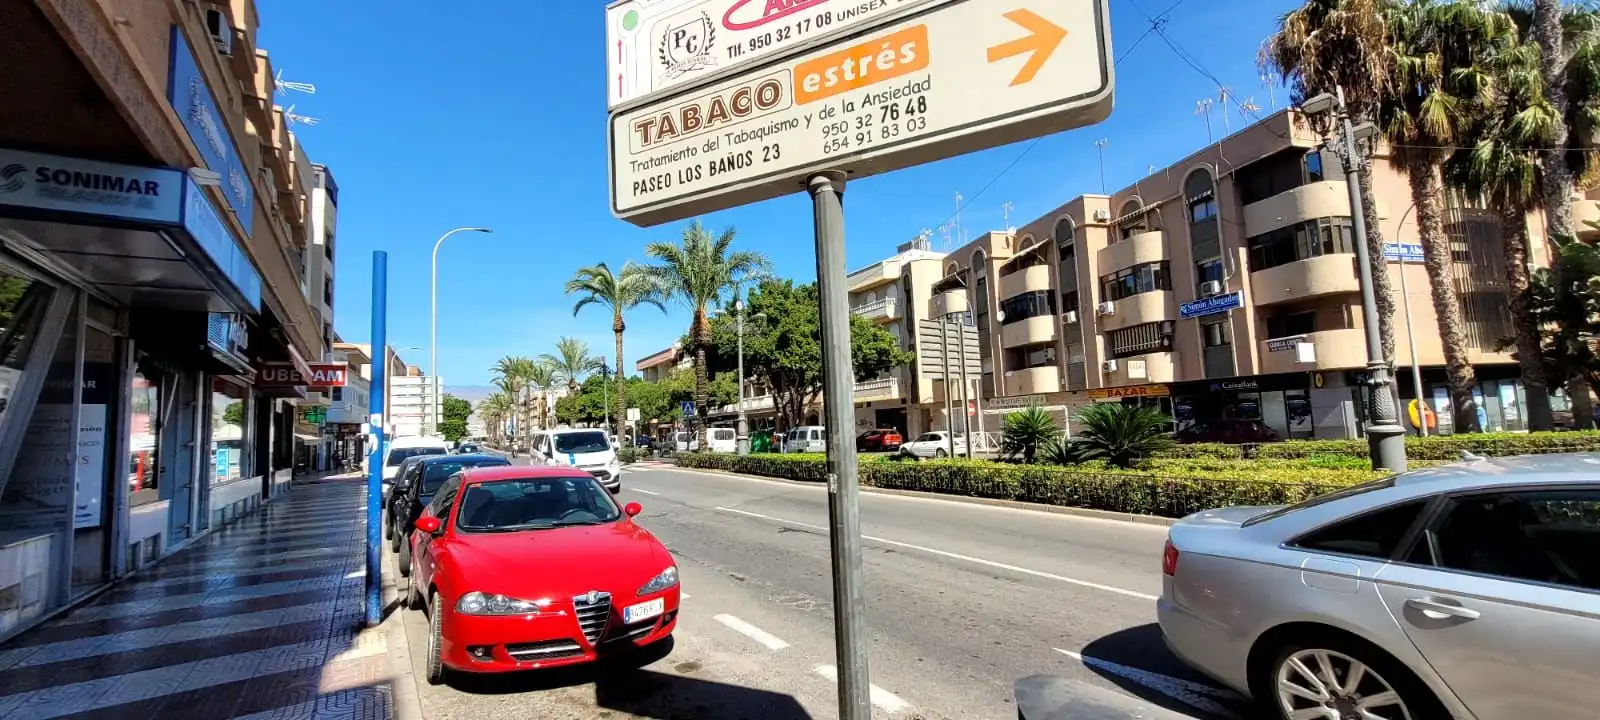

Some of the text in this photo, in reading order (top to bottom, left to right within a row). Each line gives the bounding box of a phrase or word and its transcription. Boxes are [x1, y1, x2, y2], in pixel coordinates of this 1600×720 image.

[727, 0, 887, 59] Tlf. 950 32 17 08 UNISEX
[634, 41, 916, 147] TABACO estrés
[822, 95, 927, 139] 950 32 76 48
[629, 73, 931, 173] Tratamiento del Tabaquismo y de la Ansiedad
[823, 116, 926, 154] 654 91 83 03
[35, 166, 160, 196] SONIMAR
[633, 143, 780, 197] PASEO LOS BAÑOS 23
[1107, 387, 1148, 397] BAZAR
